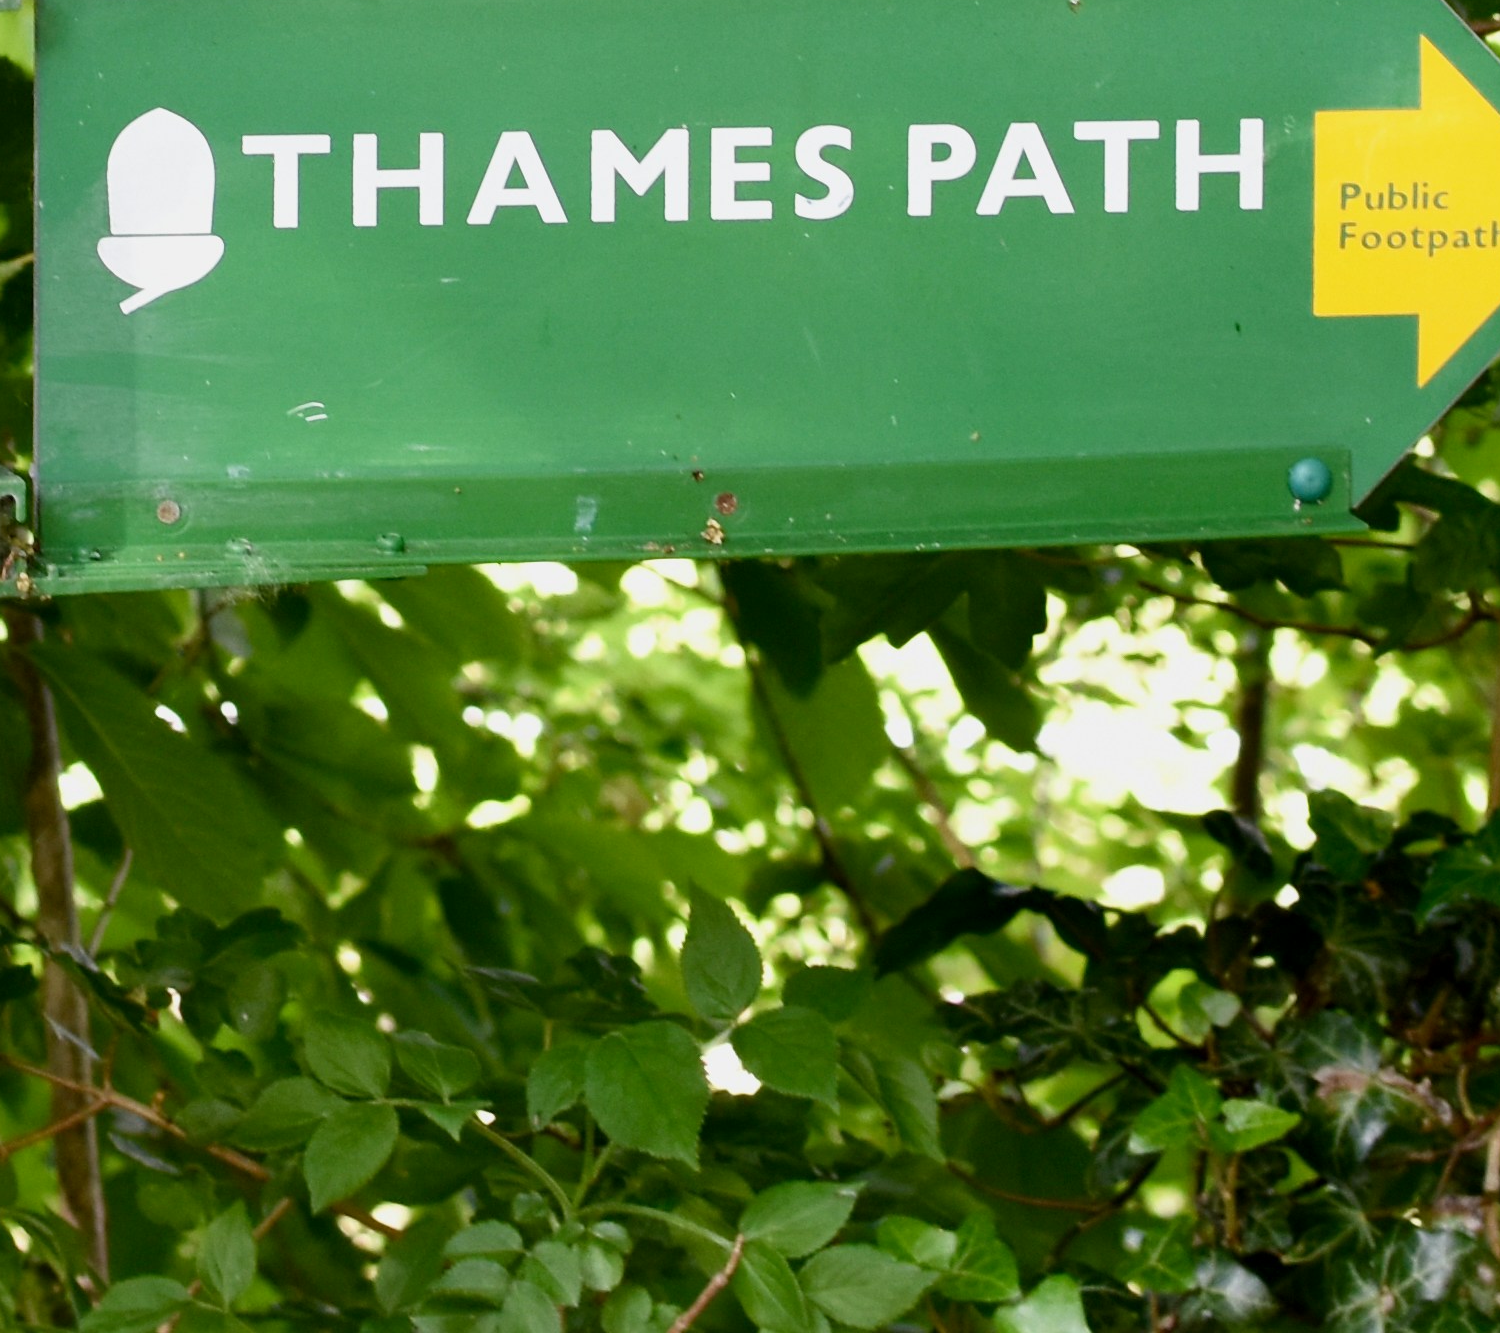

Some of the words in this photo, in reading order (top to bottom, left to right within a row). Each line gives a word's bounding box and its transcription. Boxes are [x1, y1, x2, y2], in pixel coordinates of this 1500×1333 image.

[241, 122, 856, 231] THAMES
[906, 117, 1267, 217] PATH
[1340, 181, 1449, 211] Public
